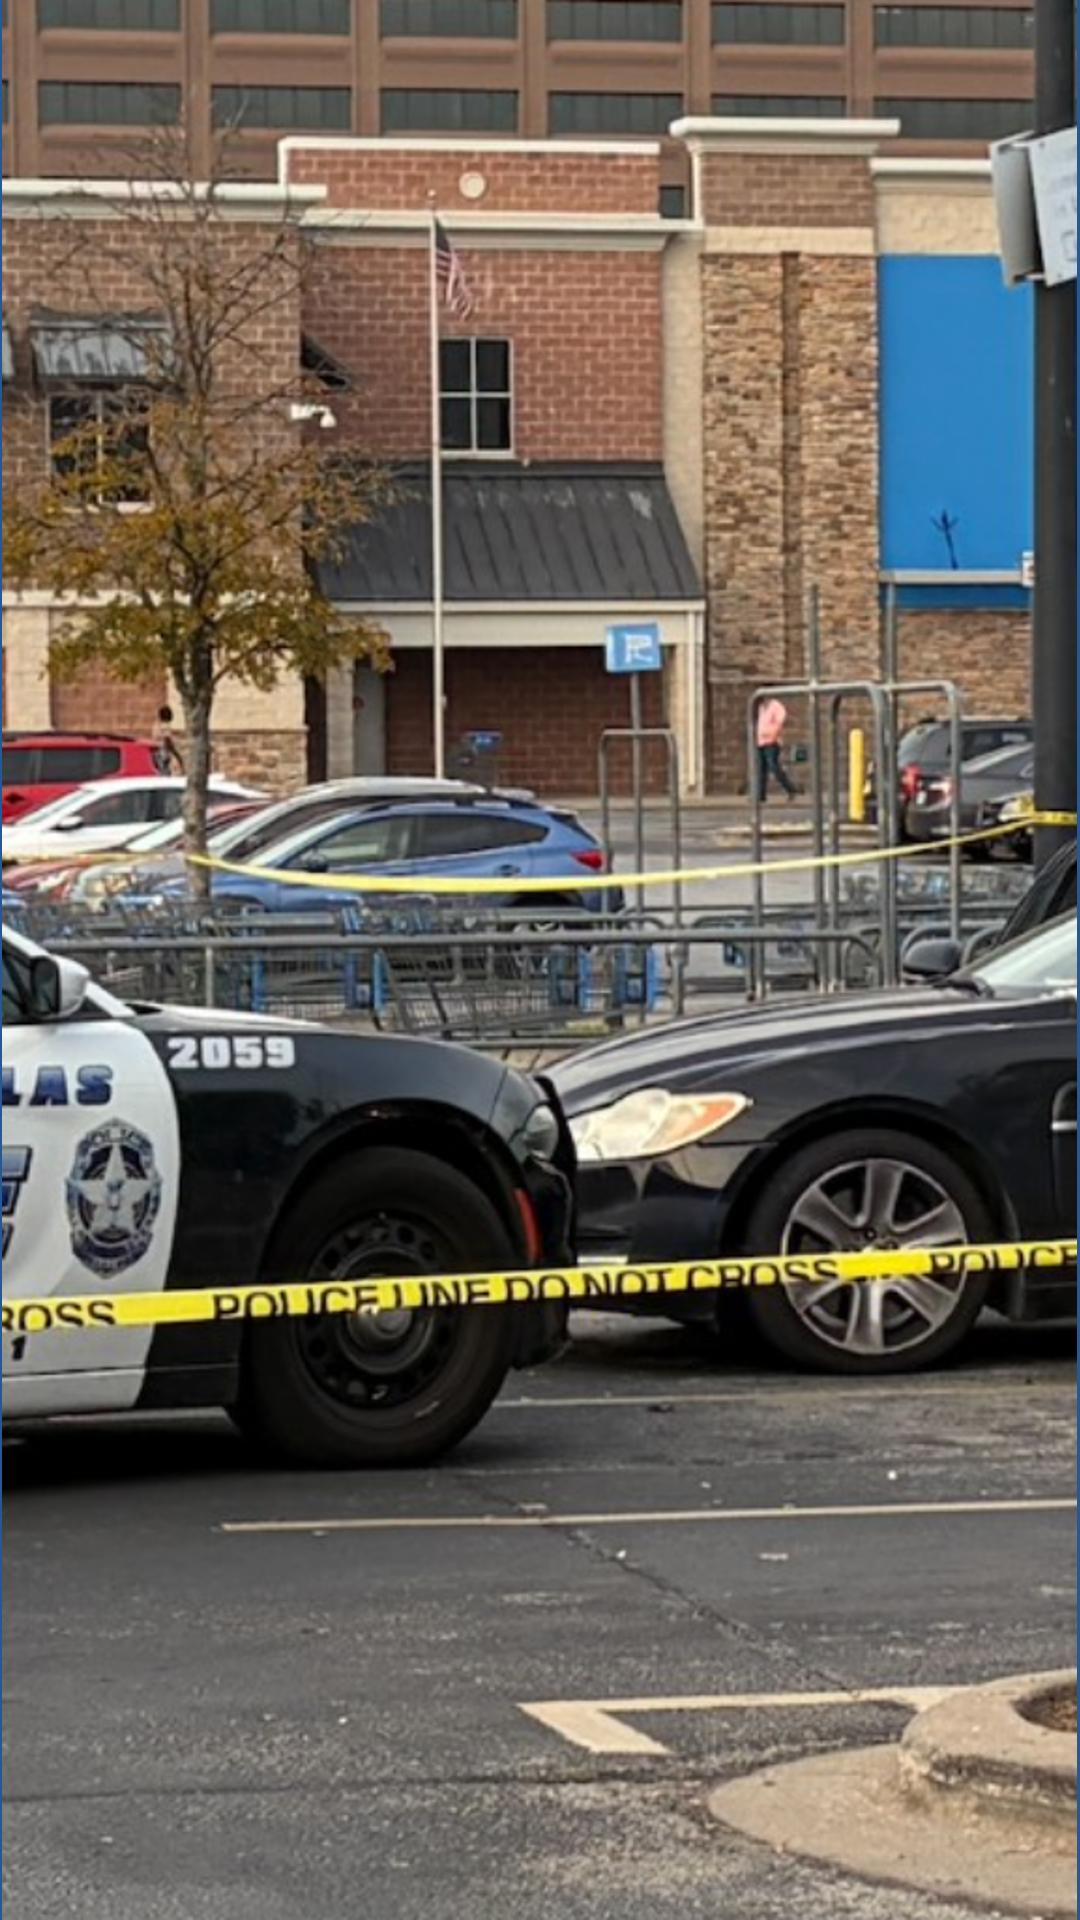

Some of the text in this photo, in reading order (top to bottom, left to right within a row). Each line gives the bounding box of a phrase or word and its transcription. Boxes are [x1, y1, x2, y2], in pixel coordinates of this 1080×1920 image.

[167, 1035, 296, 1069] 2059
[213, 1285, 379, 1318] POLICE
[394, 1278, 491, 1309] LINE
[505, 1275, 569, 1302] DO
[584, 1267, 673, 1297] NOT
[686, 1258, 838, 1291] CROSS
